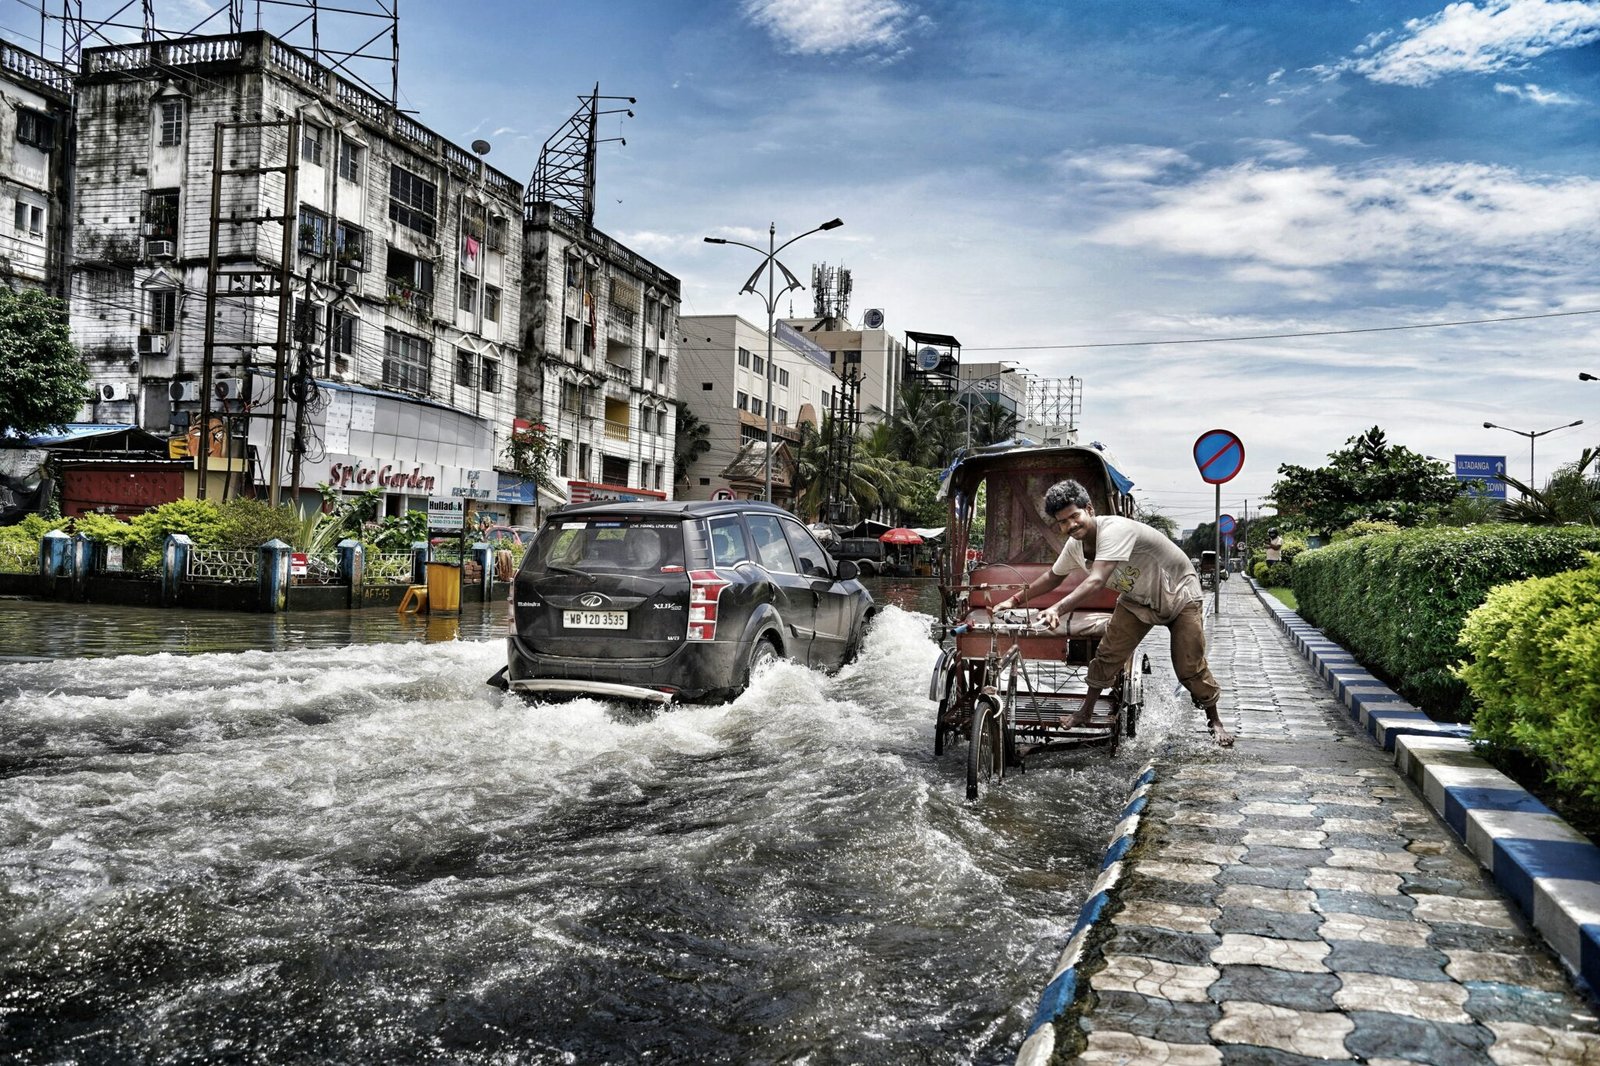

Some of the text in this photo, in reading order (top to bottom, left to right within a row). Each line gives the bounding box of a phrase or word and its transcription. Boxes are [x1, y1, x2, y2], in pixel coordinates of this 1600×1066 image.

[1457, 461, 1490, 470] ULTADANGA
[329, 460, 435, 490] Spice Garden
[1486, 482, 1505, 492] TOWN
[570, 613, 581, 624] WB
[603, 615, 625, 626] 3535
